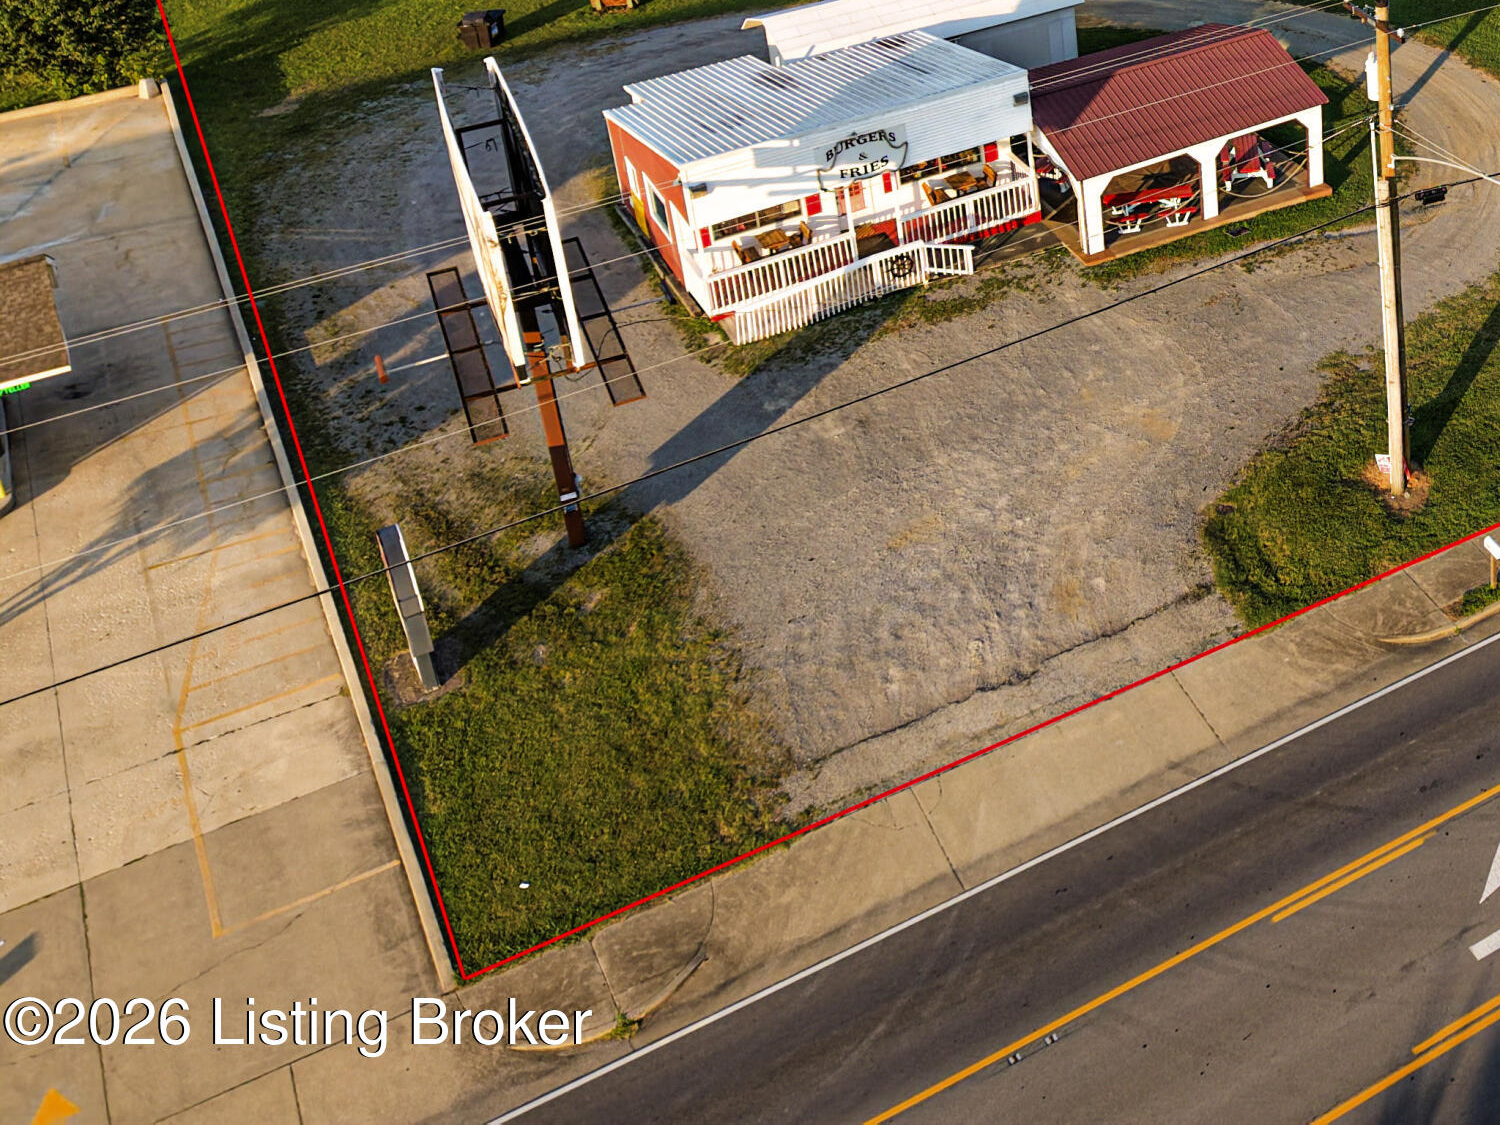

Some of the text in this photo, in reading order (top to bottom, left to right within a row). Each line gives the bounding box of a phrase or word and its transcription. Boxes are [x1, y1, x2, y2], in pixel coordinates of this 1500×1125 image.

[825, 130, 896, 162] BURGERS
[858, 152, 868, 160] &
[840, 155, 889, 179] FRIES
